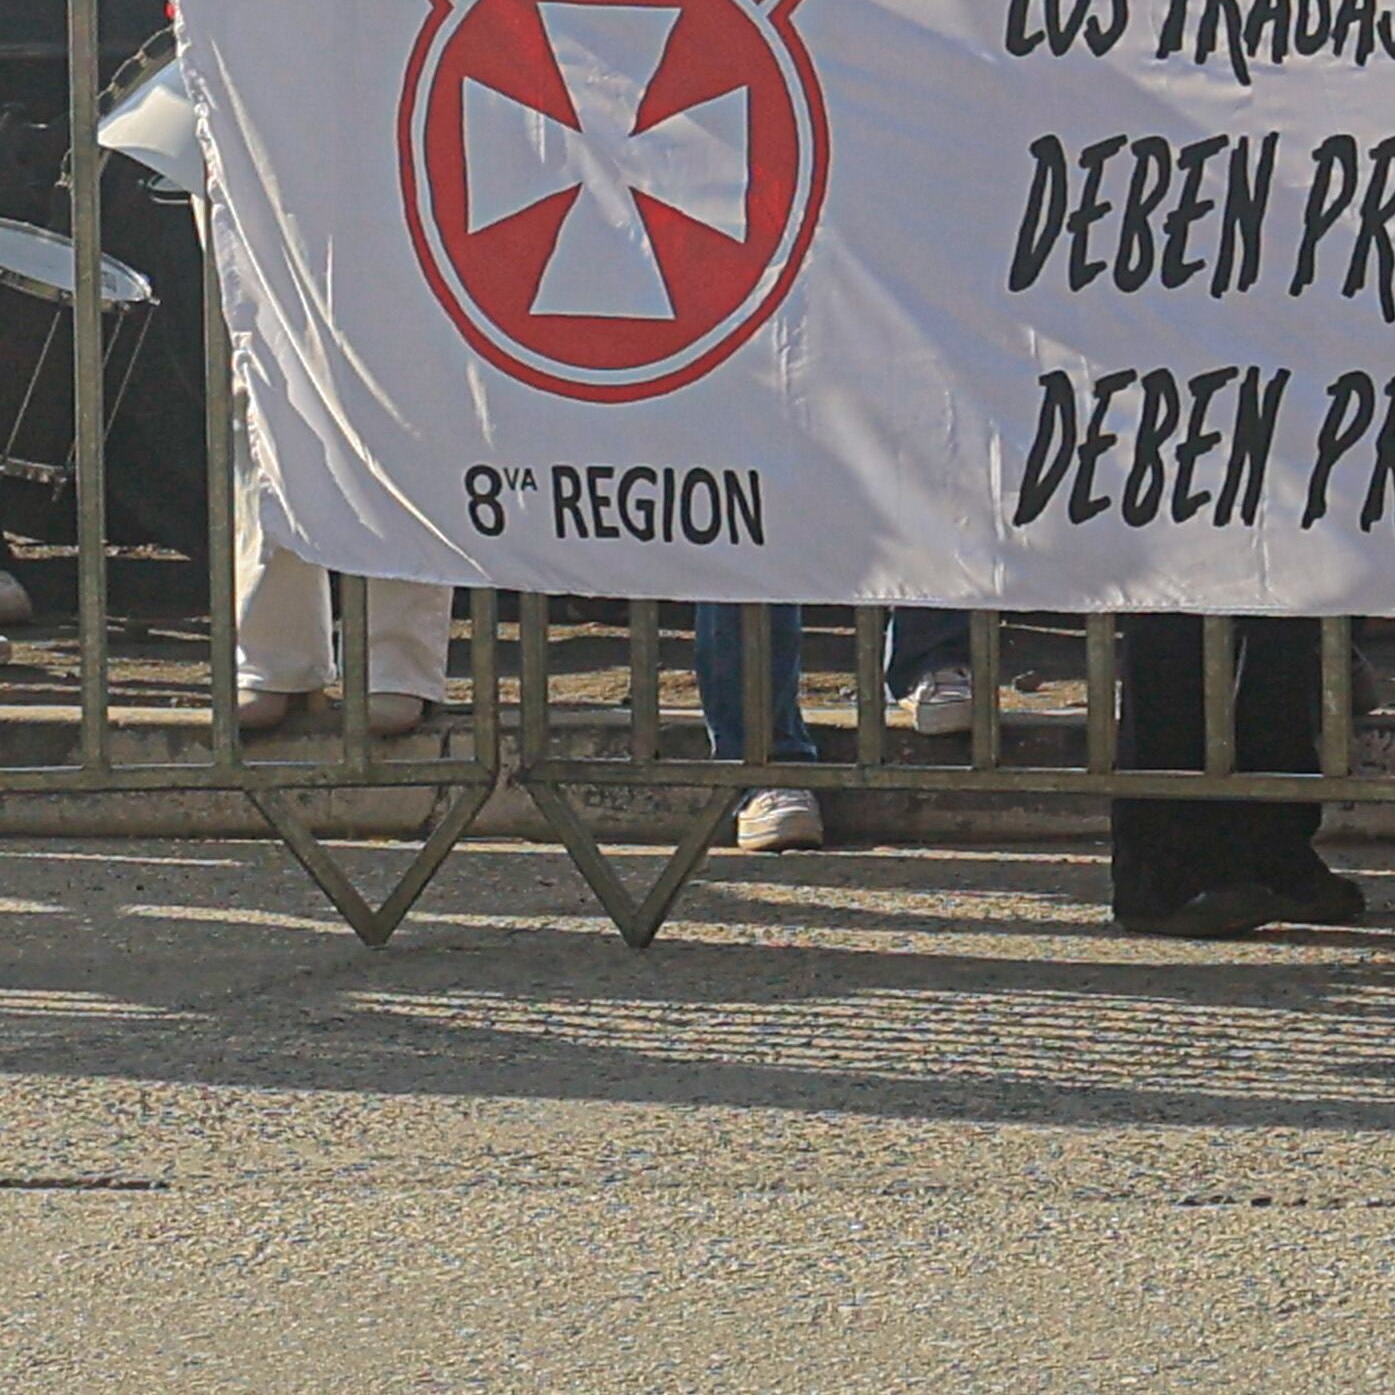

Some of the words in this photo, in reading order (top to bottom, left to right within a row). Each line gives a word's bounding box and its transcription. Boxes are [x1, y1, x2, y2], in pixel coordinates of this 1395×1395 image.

[1008, 131, 1280, 299] DEBEN
[551, 465, 765, 546] REGION
[1012, 365, 1292, 528] DEBEN
